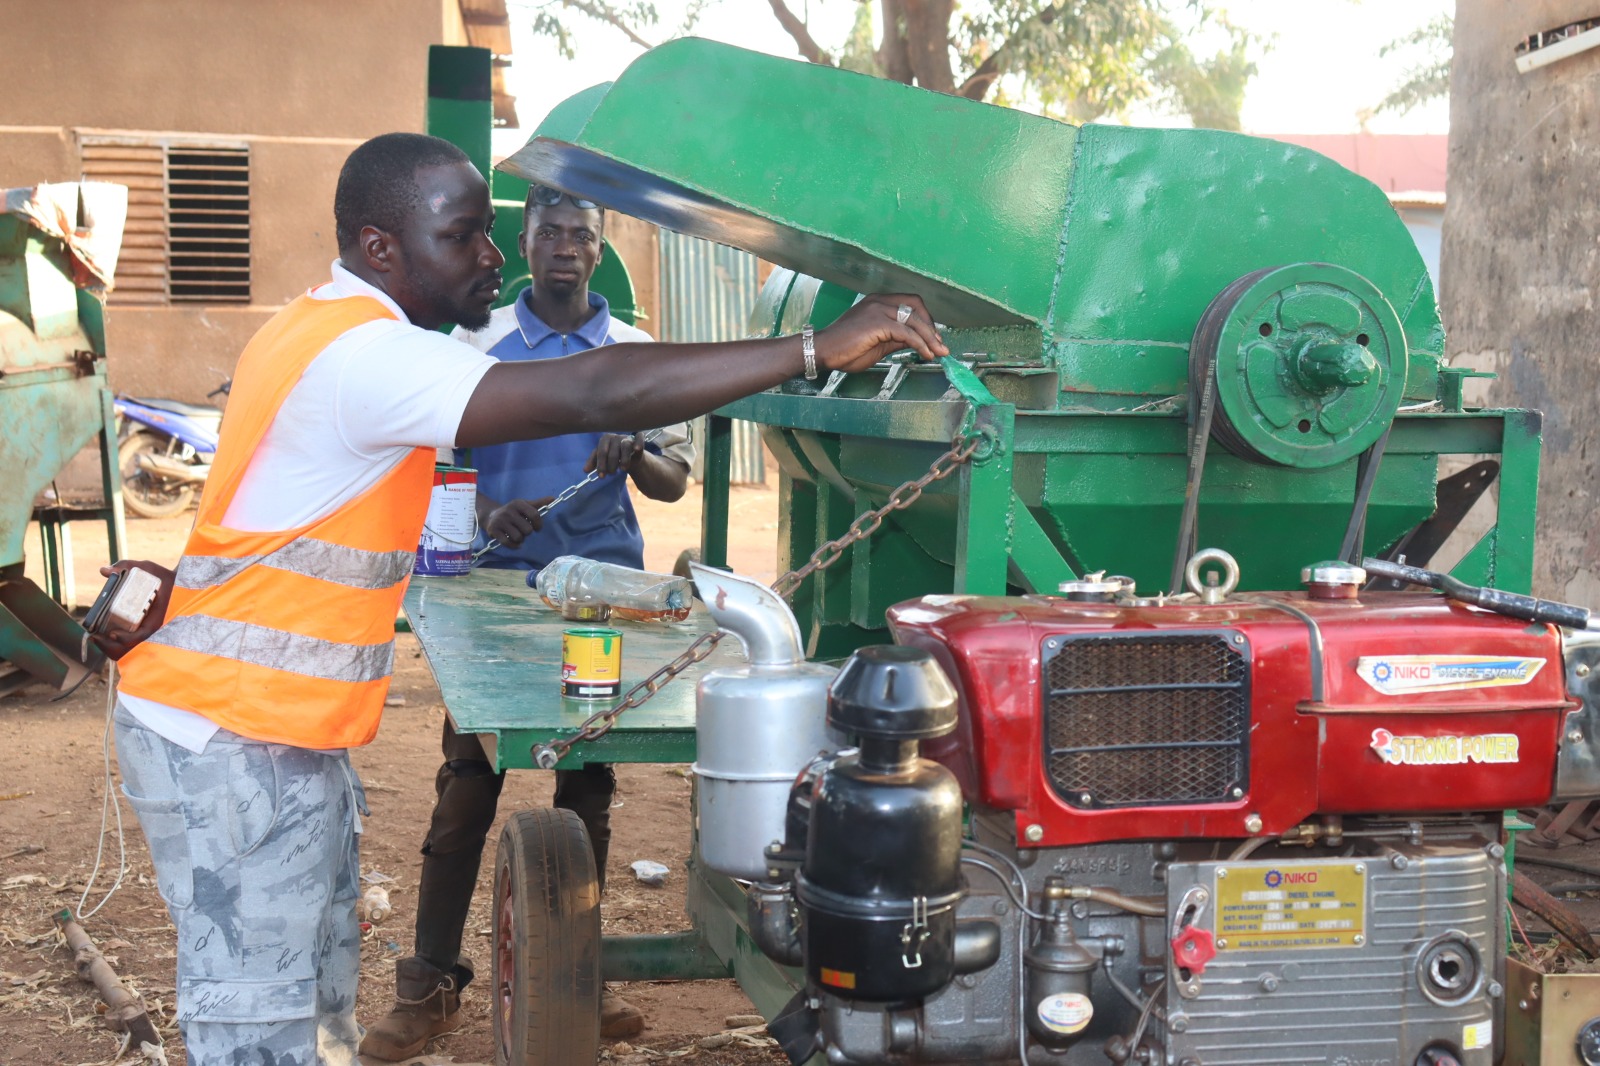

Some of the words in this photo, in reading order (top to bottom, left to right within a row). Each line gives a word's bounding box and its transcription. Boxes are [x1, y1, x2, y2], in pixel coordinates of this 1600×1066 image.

[1395, 666, 1430, 679] NIKO
[1438, 667, 1480, 678] DIESEL
[1482, 668, 1527, 679] ENGINE
[1390, 736, 1458, 764] STRONG
[1462, 734, 1519, 763] POWER
[1285, 872, 1318, 884] NIKO
